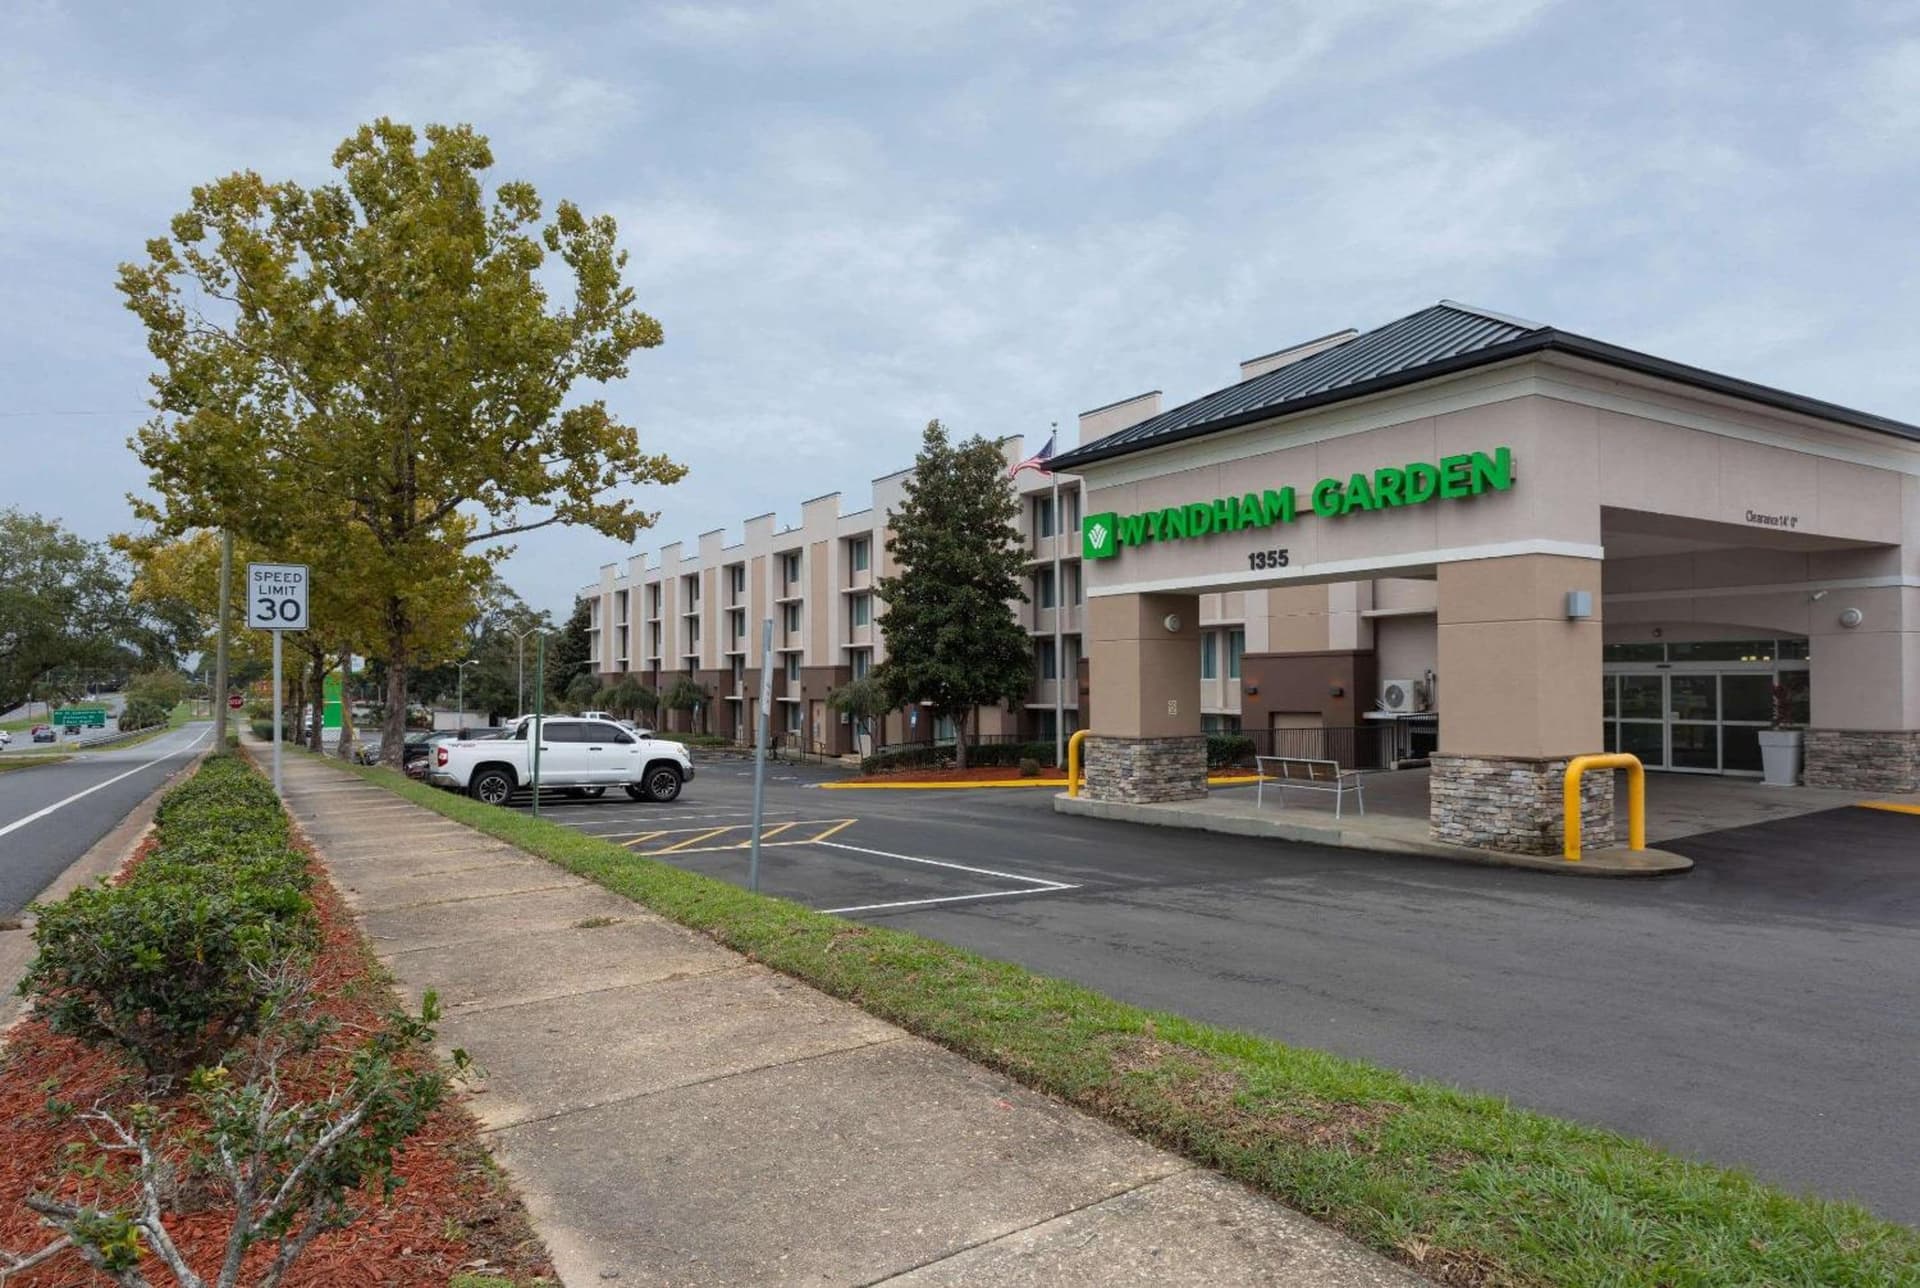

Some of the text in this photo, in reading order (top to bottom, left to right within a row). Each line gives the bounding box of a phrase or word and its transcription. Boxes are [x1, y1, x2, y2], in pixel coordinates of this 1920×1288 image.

[1118, 446, 1512, 547] WYNDHAM GARDEN
[1745, 510, 1778, 526] Clearance
[1248, 548, 1289, 571] 1355
[254, 571, 302, 583] SPEED
[258, 584, 297, 596] LIMIT
[256, 598, 301, 622] 30
